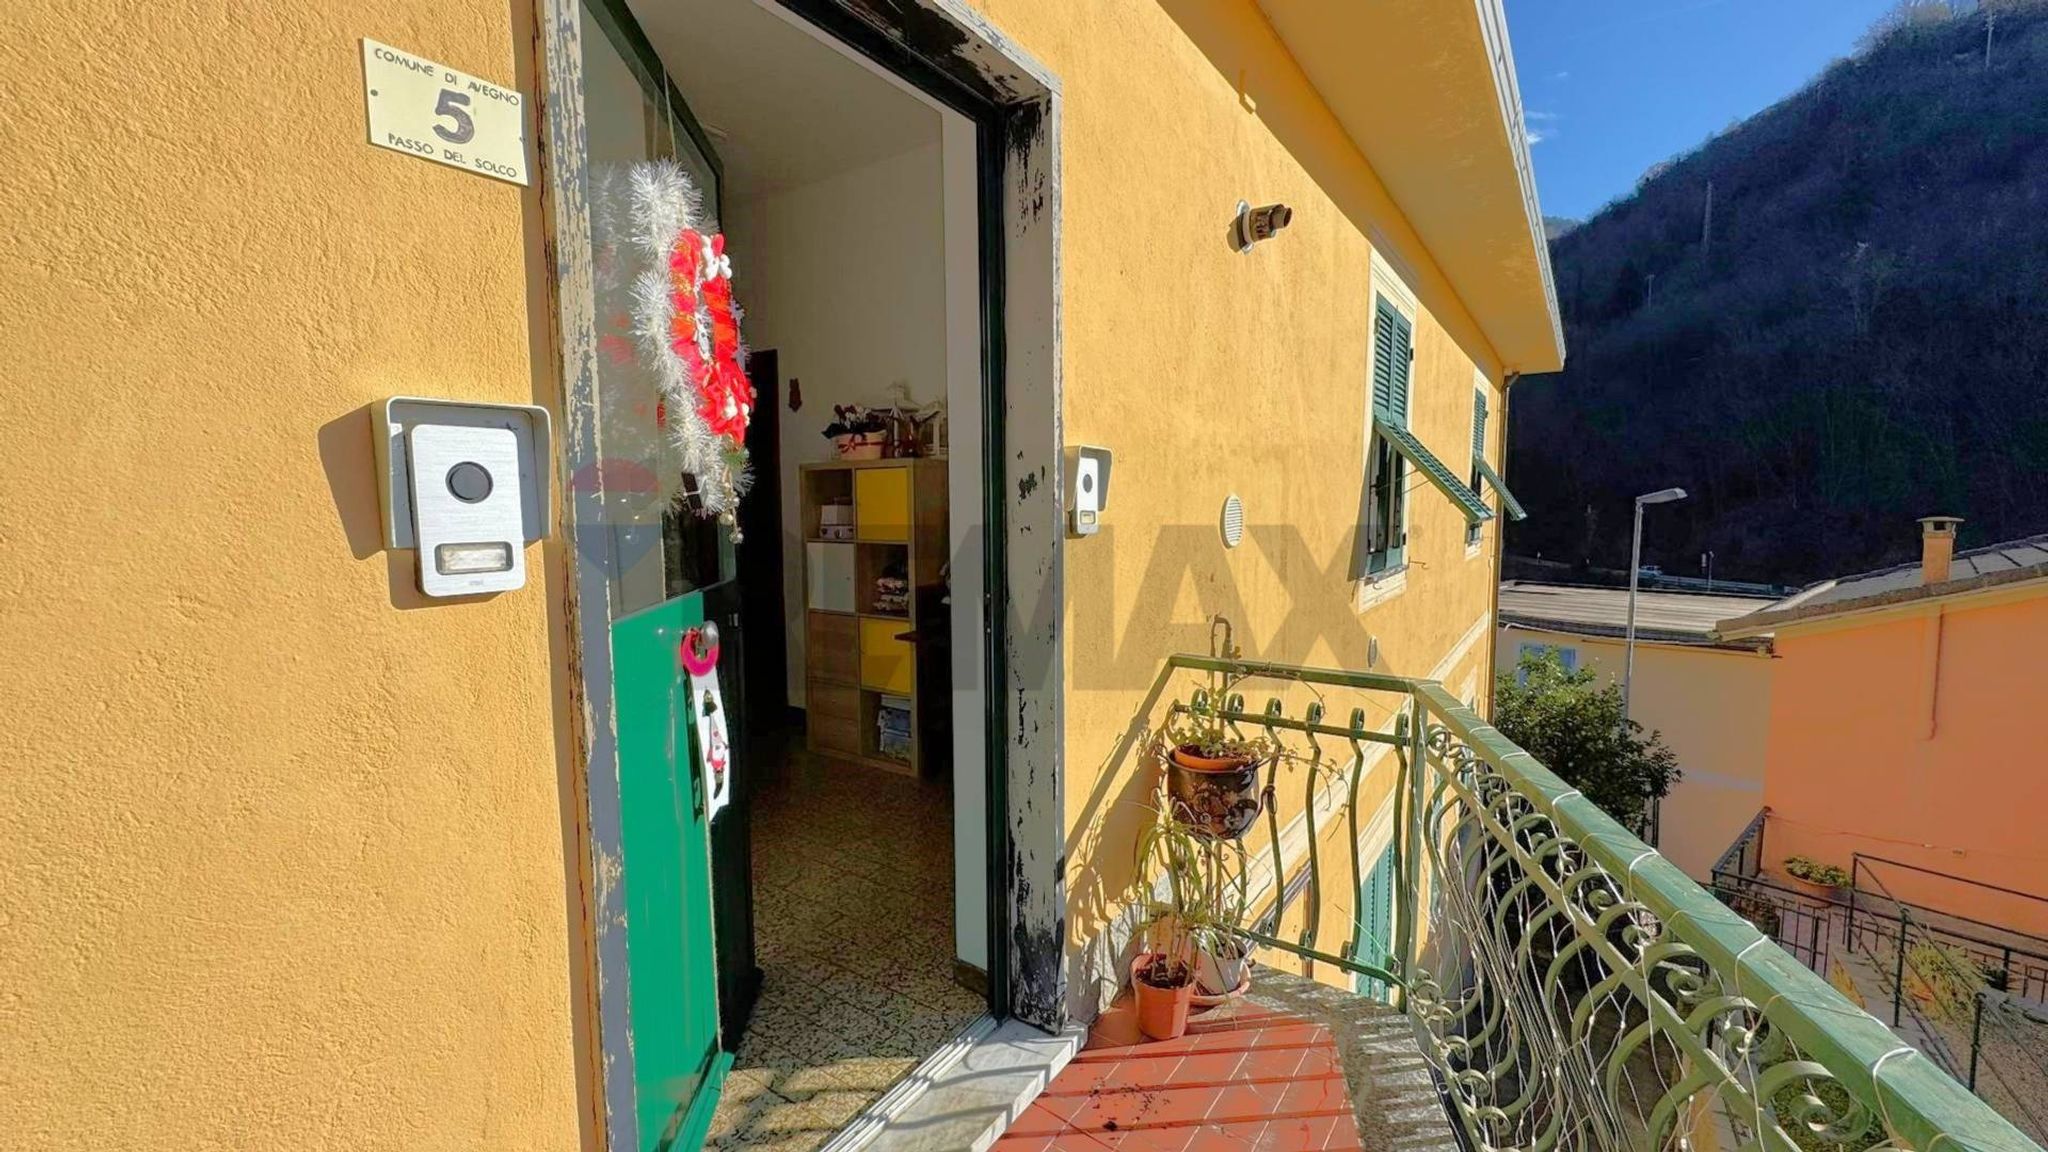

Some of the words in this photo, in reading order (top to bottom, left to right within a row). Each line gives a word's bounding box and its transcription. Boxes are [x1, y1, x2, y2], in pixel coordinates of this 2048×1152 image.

[374, 48, 434, 77] COMUNE
[444, 72, 458, 86] DI
[468, 81, 520, 106] AVEGNO
[432, 88, 475, 144] 5
[388, 132, 434, 155] PASSO
[444, 149, 467, 165] DEL
[475, 158, 517, 178] SOLCO
